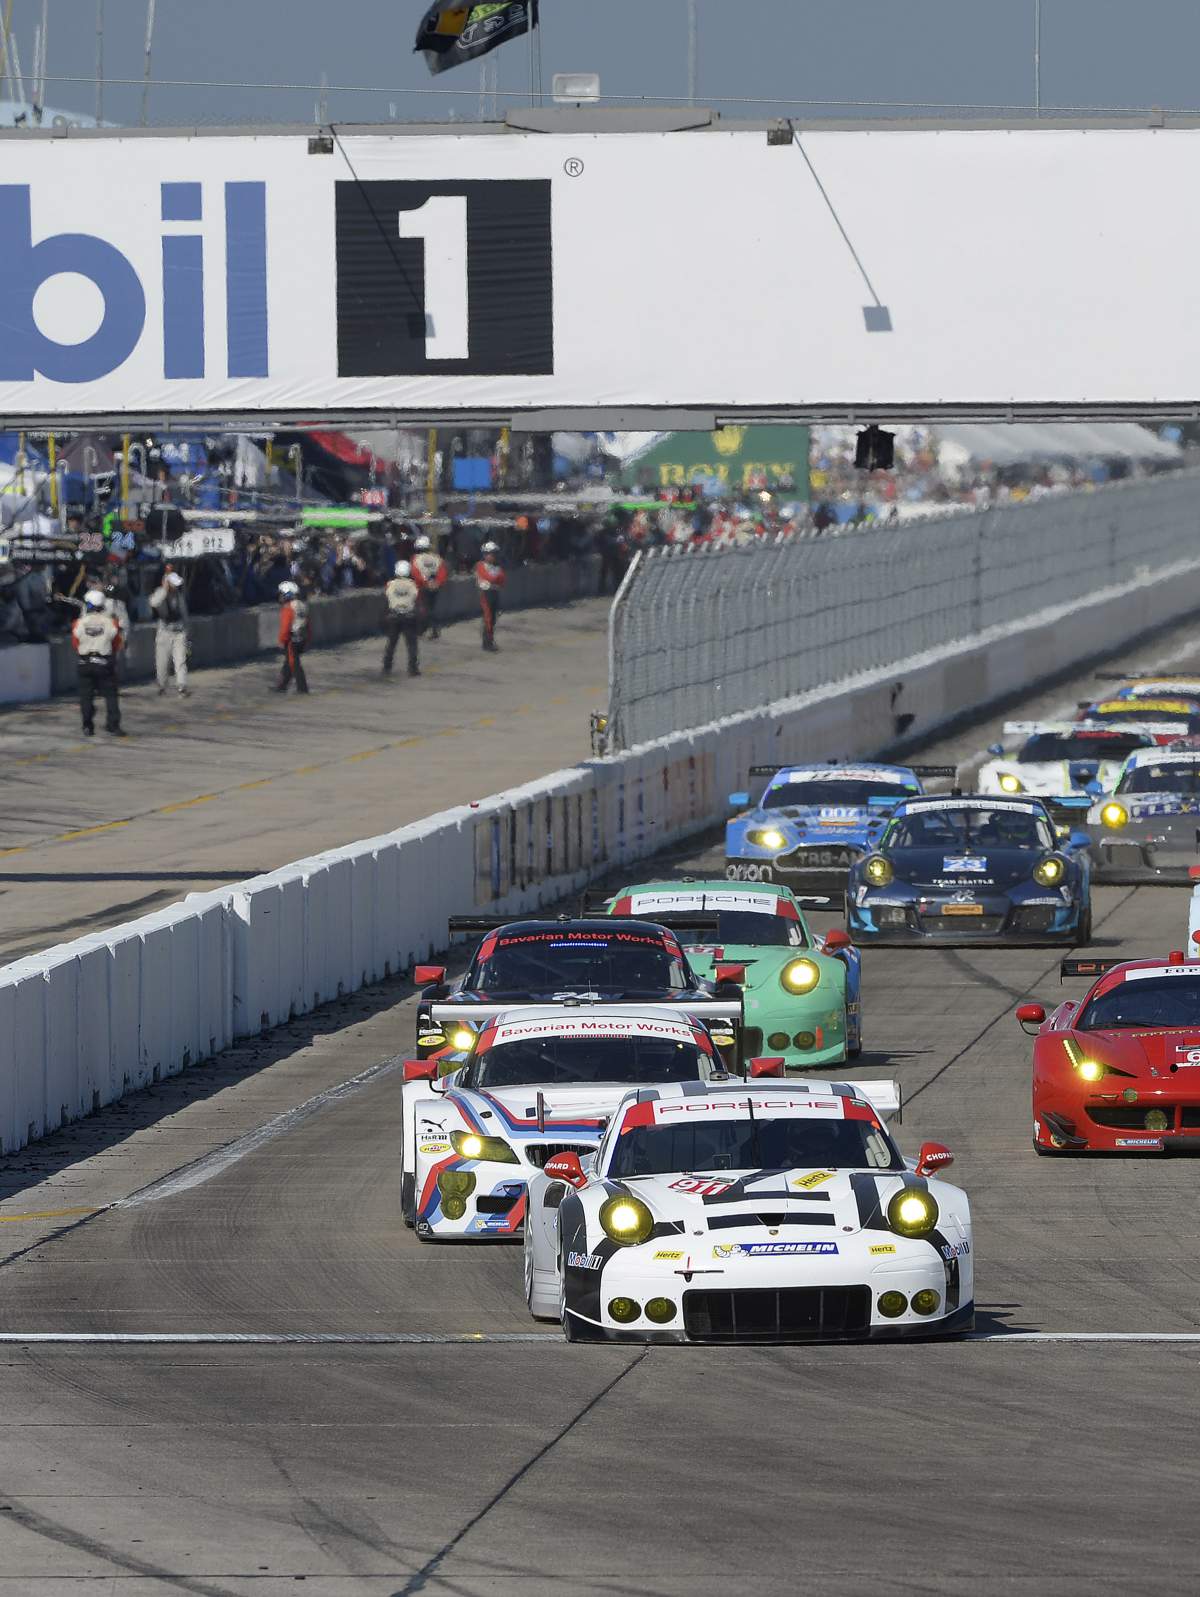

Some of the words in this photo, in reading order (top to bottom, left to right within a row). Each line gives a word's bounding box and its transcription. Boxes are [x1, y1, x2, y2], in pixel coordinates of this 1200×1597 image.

[398, 195, 470, 360] 1
[111, 533, 135, 549] 24
[638, 895, 771, 906] PORSCHE
[499, 933, 563, 946] Bavarian
[568, 932, 614, 940] Motor
[615, 933, 664, 946] Works
[501, 1023, 576, 1037] Bavarian
[582, 1022, 632, 1030] Motor
[637, 1023, 691, 1037] Works
[659, 1101, 838, 1115] PORSCHE
[1125, 1138, 1160, 1146] MICHELIN
[926, 1152, 954, 1161] CHOPA
[544, 1162, 569, 1170] OPARD
[799, 1171, 826, 1188] Hertz
[673, 1178, 728, 1196] 911
[751, 1243, 836, 1253] MICHELIN
[871, 1246, 894, 1254] Hertz
[655, 1252, 681, 1260] Hertz
